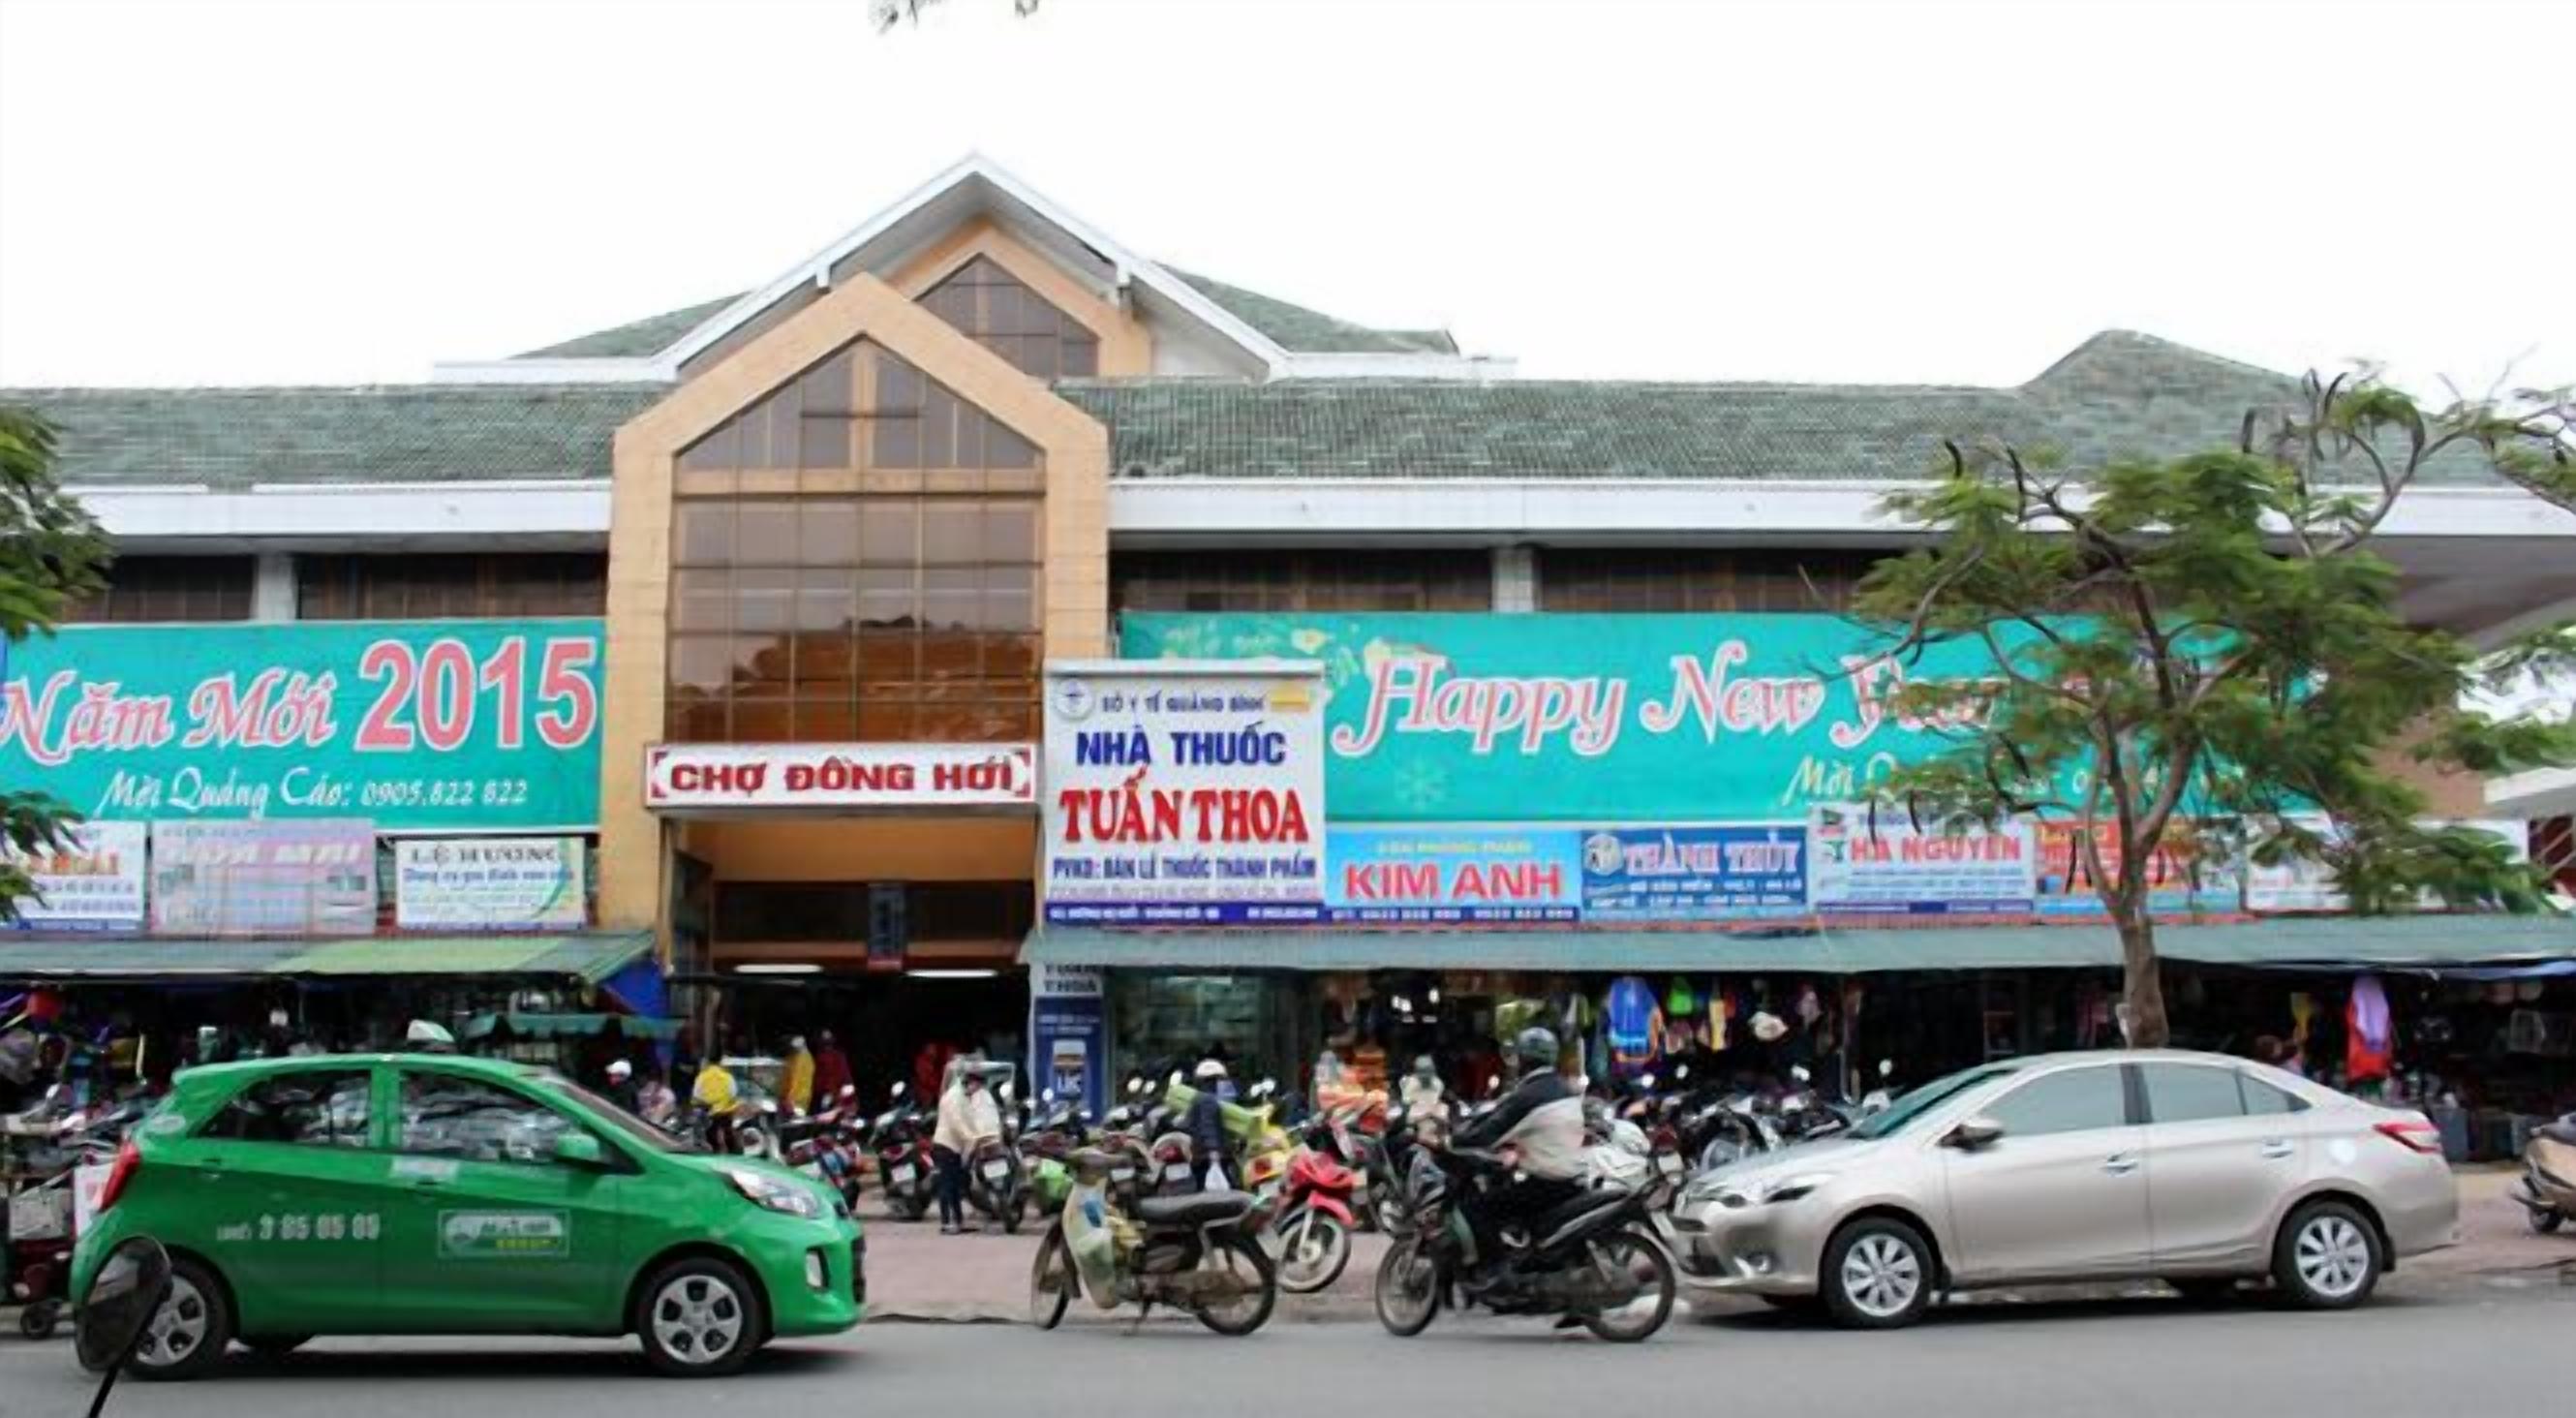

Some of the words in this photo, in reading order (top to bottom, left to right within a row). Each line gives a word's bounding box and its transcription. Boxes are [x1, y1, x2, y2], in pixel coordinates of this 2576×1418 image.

[182, 667, 337, 748] Mới
[353, 635, 597, 753] 2015
[1330, 655, 1628, 756] Happy
[1639, 639, 1825, 744] New
[1076, 724, 1152, 766] NHÀ
[1170, 721, 1286, 766] THUỐC
[671, 760, 768, 798] CHỢ
[1058, 765, 1183, 842] TUẤN
[1190, 788, 1309, 842] THOA
[1624, 831, 1721, 876] THÀNH
[1345, 862, 1439, 899] KIM
[1452, 862, 1561, 899] ANH
